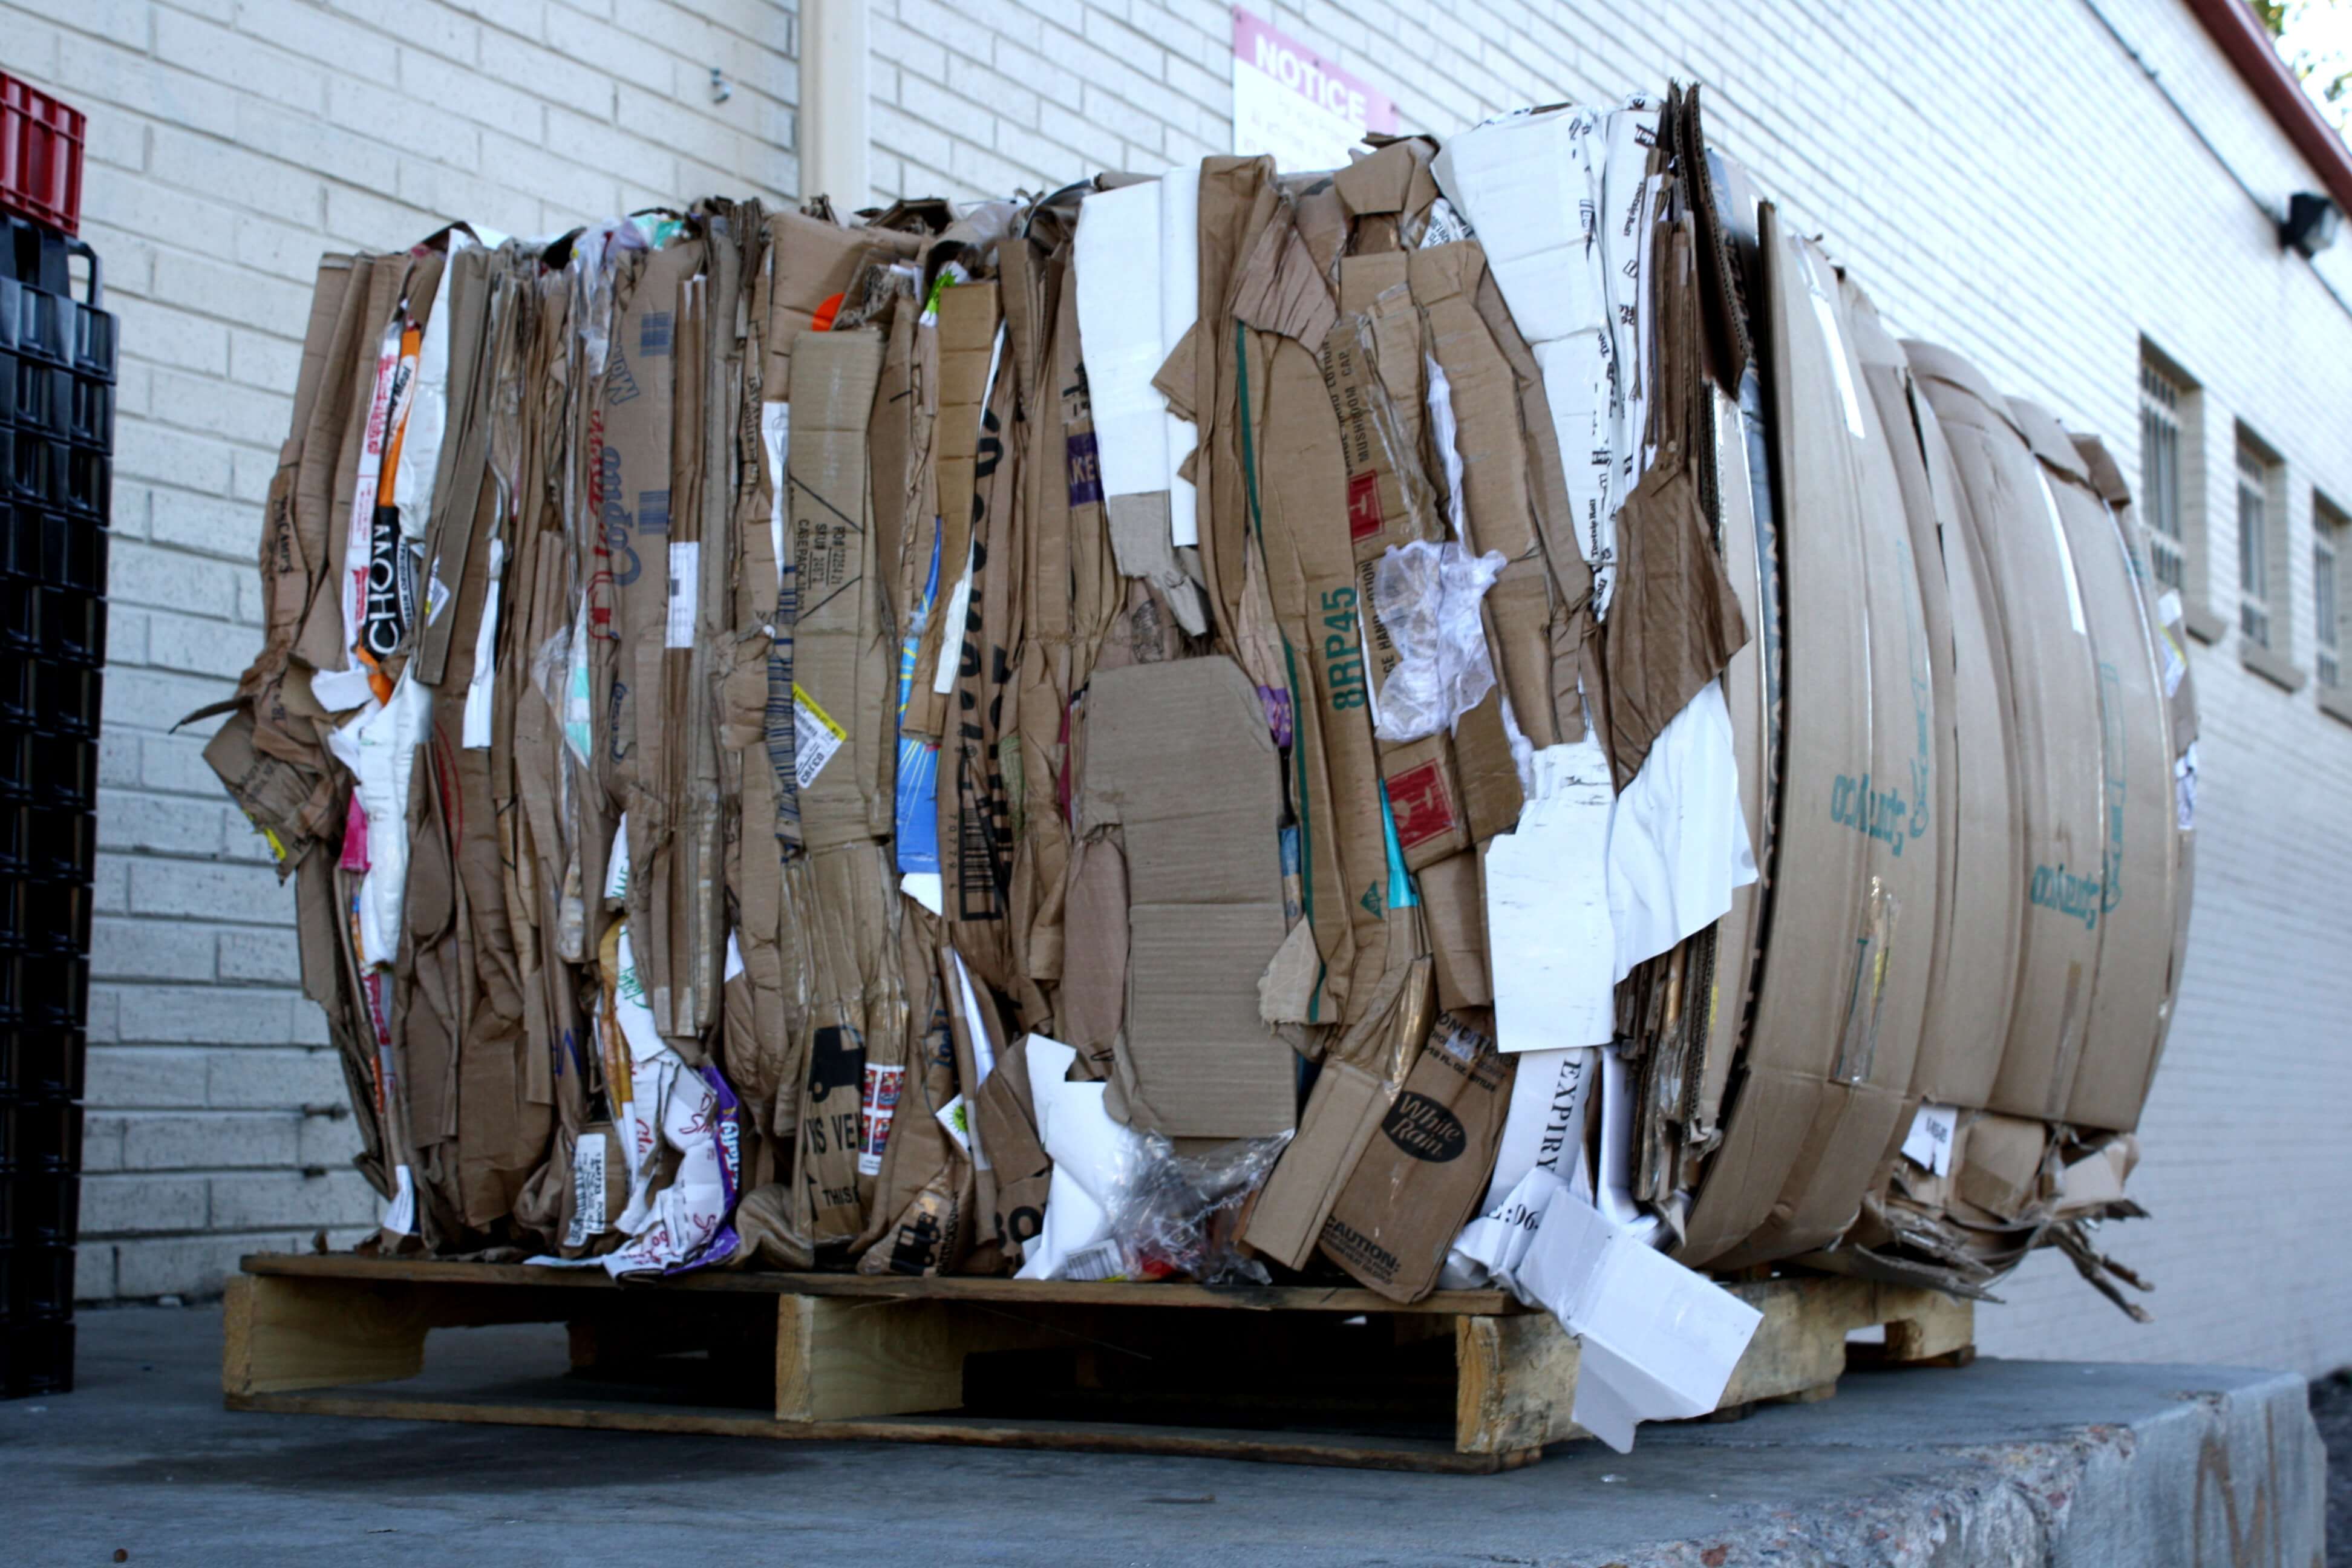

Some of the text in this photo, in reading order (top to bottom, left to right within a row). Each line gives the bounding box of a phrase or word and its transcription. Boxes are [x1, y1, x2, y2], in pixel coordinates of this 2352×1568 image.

[1255, 33, 1367, 126] NOTICE
[1339, 350, 1354, 377] CAP
[1341, 382, 1369, 463] MUSHROOM
[797, 519, 811, 547] CASE
[368, 524, 402, 655] CHOW
[1322, 586, 1366, 711] 8RP45
[1437, 1011, 1518, 1071] ONDITIONER
[1390, 1119, 1442, 1157] Rain
[1398, 1093, 1460, 1142] White
[1537, 1059, 1582, 1172] EXPIRY
[822, 1186, 852, 1207] THIS
